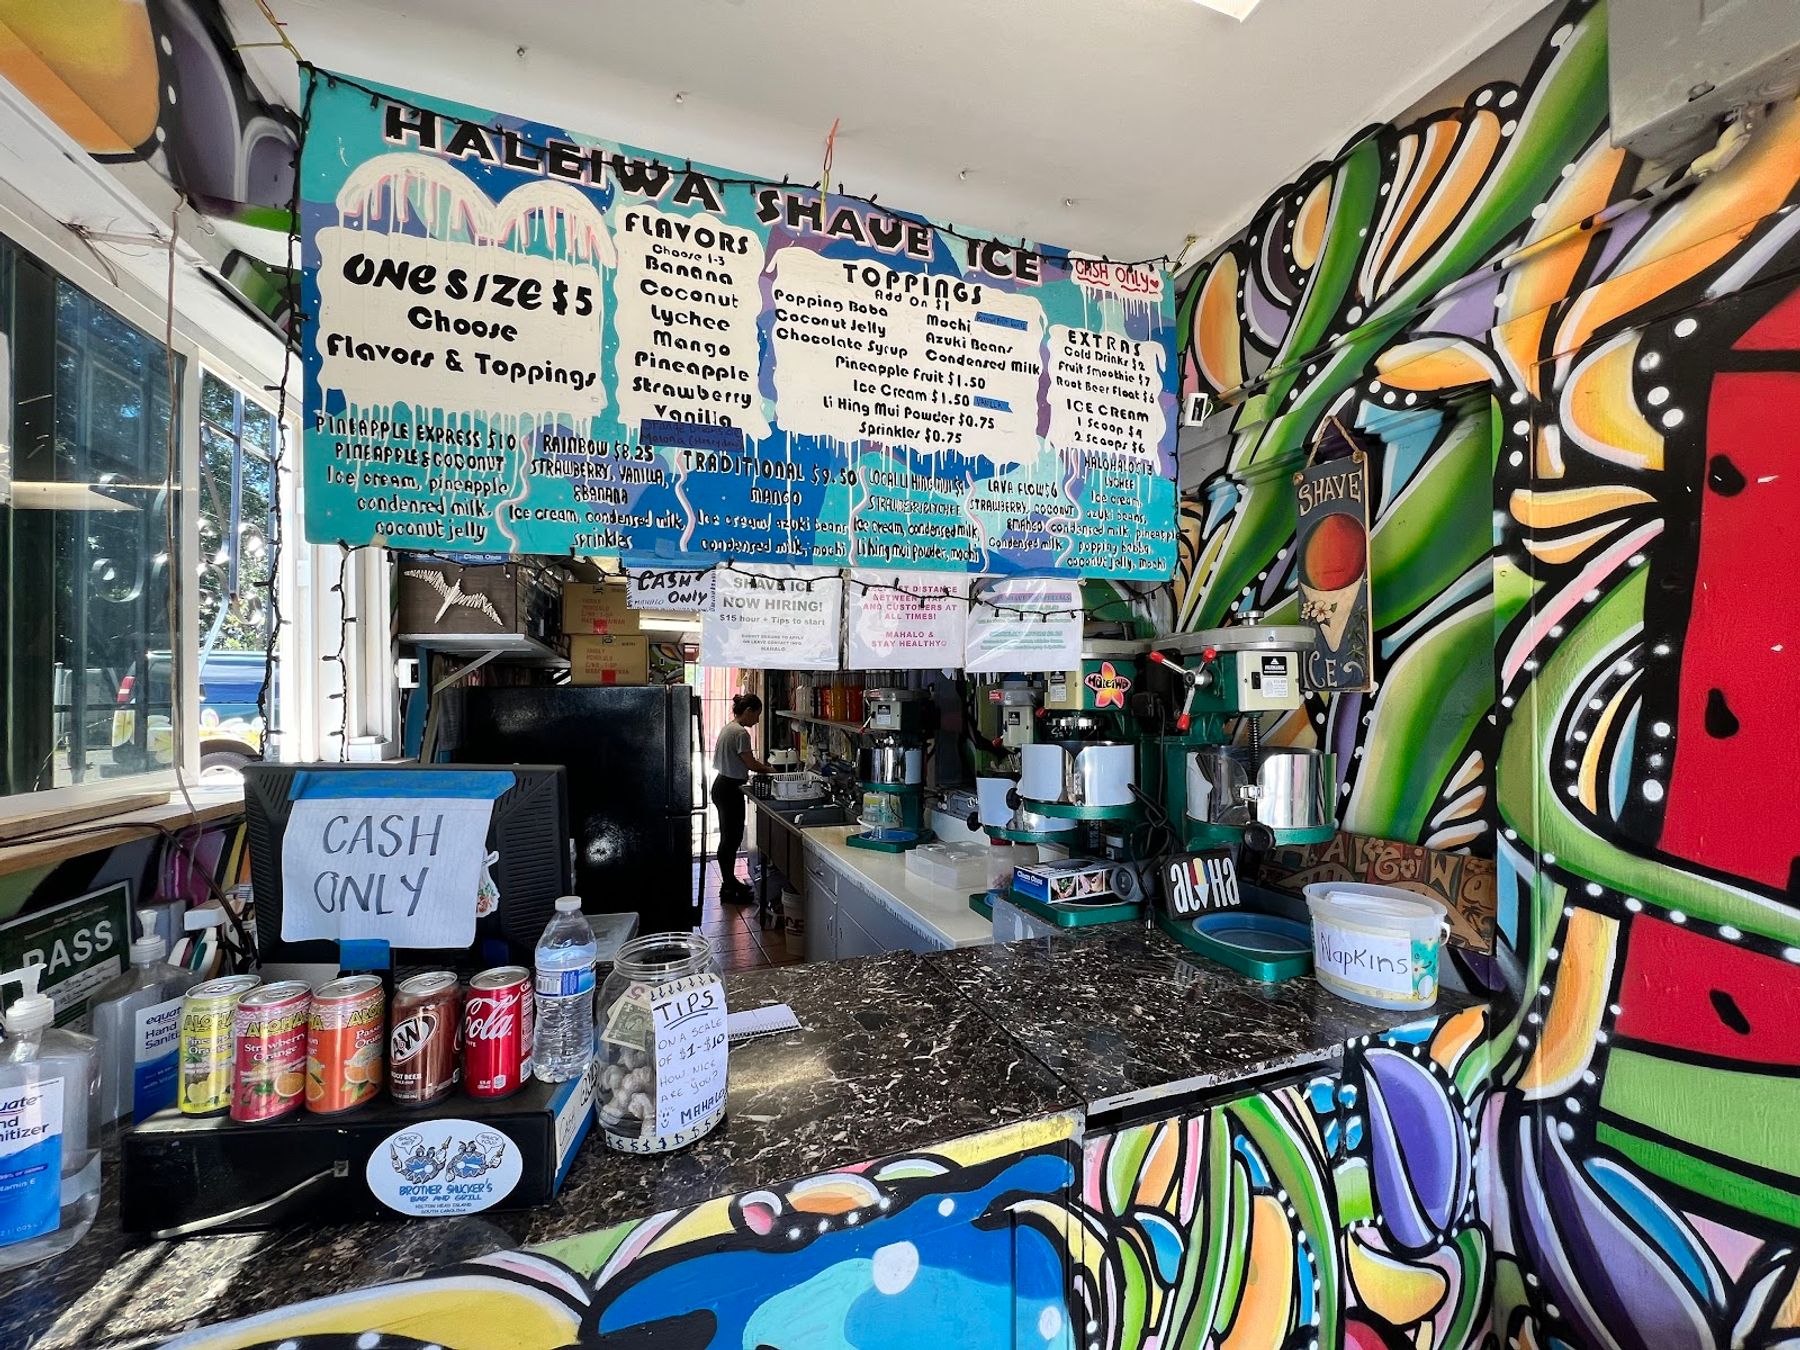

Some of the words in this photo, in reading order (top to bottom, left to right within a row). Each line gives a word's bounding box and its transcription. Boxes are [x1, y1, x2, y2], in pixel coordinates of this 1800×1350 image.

[385, 104, 723, 213] HALEIWA
[756, 189, 934, 259] SHAVE
[966, 236, 1042, 282] ICE
[624, 211, 750, 256] FLAVORS
[651, 243, 703, 265] Choose
[707, 252, 726, 267] 1-3
[644, 254, 733, 286] Banana
[1074, 258, 1109, 281] CASH
[445, 266, 542, 311] SIZE
[552, 278, 593, 316] $5
[638, 278, 740, 310] Coconut
[843, 262, 982, 305] TOPPINGS
[774, 288, 844, 313] Popping
[849, 301, 888, 318] Boba
[874, 289, 903, 303] Add
[909, 295, 928, 308] On
[935, 297, 950, 311] $1
[407, 305, 518, 342] Choose
[651, 304, 732, 332] Lychee
[774, 307, 848, 331] Coconut
[849, 319, 887, 338] Jelly
[926, 313, 971, 333] Mochi
[652, 329, 731, 358] Mango
[776, 327, 863, 351] Chocolate
[867, 339, 908, 359] Syrup
[925, 331, 967, 349] Azuki
[971, 338, 1014, 355] Beans
[1068, 329, 1141, 356] EXTRAS
[326, 332, 434, 370] Flavors
[445, 350, 463, 373] &
[474, 351, 597, 390] Toppings
[634, 350, 751, 384] Pineapple
[925, 348, 1006, 371] Condensed
[1010, 361, 1041, 376] Milk
[1064, 345, 1091, 360] Cold
[1094, 351, 1129, 367] Drinks
[1131, 357, 1146, 372] $2
[835, 355, 910, 378] Pineapple
[913, 367, 944, 384] Fruit
[948, 373, 987, 391] $1.50
[1058, 360, 1084, 374] Fruit
[1086, 364, 1135, 384] Smoothie
[1138, 373, 1151, 388] $7
[632, 375, 753, 409] Strawberry
[853, 379, 877, 395] Ice
[880, 383, 927, 402] Cream
[931, 389, 970, 407] $1.50
[1056, 375, 1082, 391] Root
[1085, 381, 1109, 394] Beer
[1112, 385, 1140, 401] Float
[1143, 390, 1155, 405] $6
[837, 397, 870, 416] Hing
[874, 402, 900, 418] Mui
[904, 406, 956, 425] Powder
[958, 413, 995, 430] $0.75
[1066, 398, 1094, 414] ICE
[1098, 404, 1149, 423] CREAM
[315, 416, 409, 441] PINEAPPLE
[416, 423, 481, 449] EXPRESS
[487, 428, 517, 452] $10
[858, 420, 921, 440] Sprinkles
[924, 428, 962, 444] $0.75
[1087, 418, 1124, 436] Scoop
[1128, 425, 1143, 439] $4
[543, 434, 610, 458] RAINBOW
[615, 441, 655, 463] $8.25
[1074, 430, 1082, 442] 2
[1086, 433, 1128, 451] Scoops
[1131, 441, 1146, 455] $6
[327, 465, 356, 485] Ice
[363, 472, 423, 492] cream,
[429, 475, 509, 498] pineapple
[683, 450, 805, 482] TRADITIONAL
[811, 463, 858, 486] $9.50
[751, 487, 802, 506] MANGO
[988, 479, 1014, 494] LAVA
[1104, 477, 1135, 490] LYCHEE
[1298, 470, 1363, 518] SHAVE
[357, 493, 447, 517] condensed
[509, 505, 530, 521] Ice
[585, 509, 653, 528] condensed
[697, 509, 720, 526] Ice
[1034, 503, 1075, 516] COCONUT
[375, 519, 446, 538] coconut
[446, 518, 487, 544] jelly
[572, 527, 633, 549] sprinkles
[638, 570, 692, 591] CASH
[723, 597, 760, 609] NOW
[765, 599, 823, 612] HIRING!
[739, 615, 760, 623] hour
[771, 616, 790, 625] Tips
[793, 617, 802, 625] to
[804, 618, 825, 626] start
[1302, 650, 1338, 689] ICE
[323, 814, 445, 857] CASH
[313, 866, 430, 917] ONLY
[22, 919, 114, 976] PASS
[146, 1007, 182, 1025] equat
[653, 988, 714, 1022] TIPS
[145, 1022, 177, 1040] Hand
[246, 1011, 308, 1038] ALOHA
[691, 1018, 723, 1037] SCALE
[244, 1033, 305, 1052] Strawberry
[253, 1046, 298, 1062] Orange
[658, 1053, 672, 1068] OF
[659, 1070, 686, 1088] HOW
[692, 1060, 716, 1074] NICE
[661, 1088, 684, 1103] ARE
[399, 1183, 442, 1196] BROTHER
[446, 1178, 493, 1195] SHUCKER'S
[410, 1195, 428, 1203] BAR
[433, 1194, 450, 1202] AND
